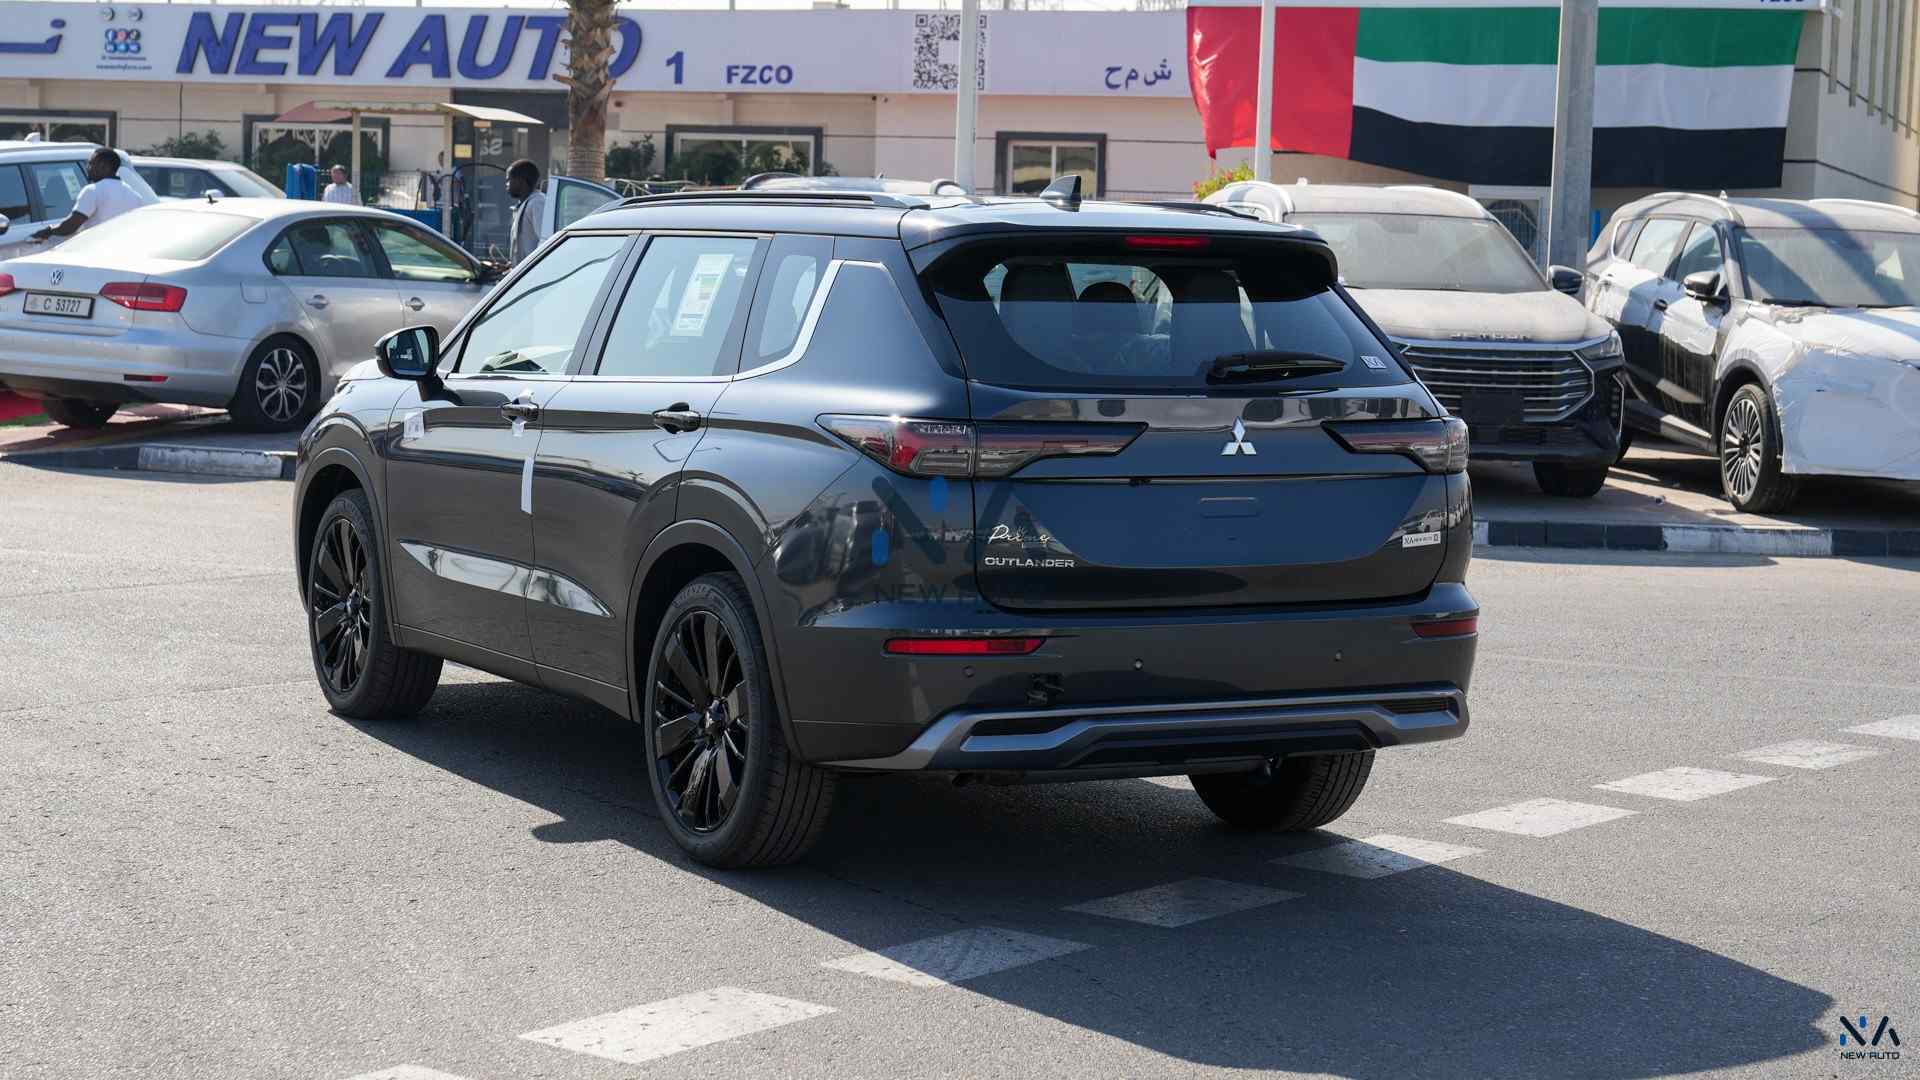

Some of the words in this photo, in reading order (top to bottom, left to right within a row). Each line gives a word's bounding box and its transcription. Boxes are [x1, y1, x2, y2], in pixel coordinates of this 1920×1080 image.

[176, 12, 385, 76] NEW
[665, 51, 684, 84] 1
[726, 65, 793, 84] FZCO
[44, 298, 52, 310] C
[56, 298, 81, 313] 53727
[984, 557, 1076, 569] OUTLANDER
